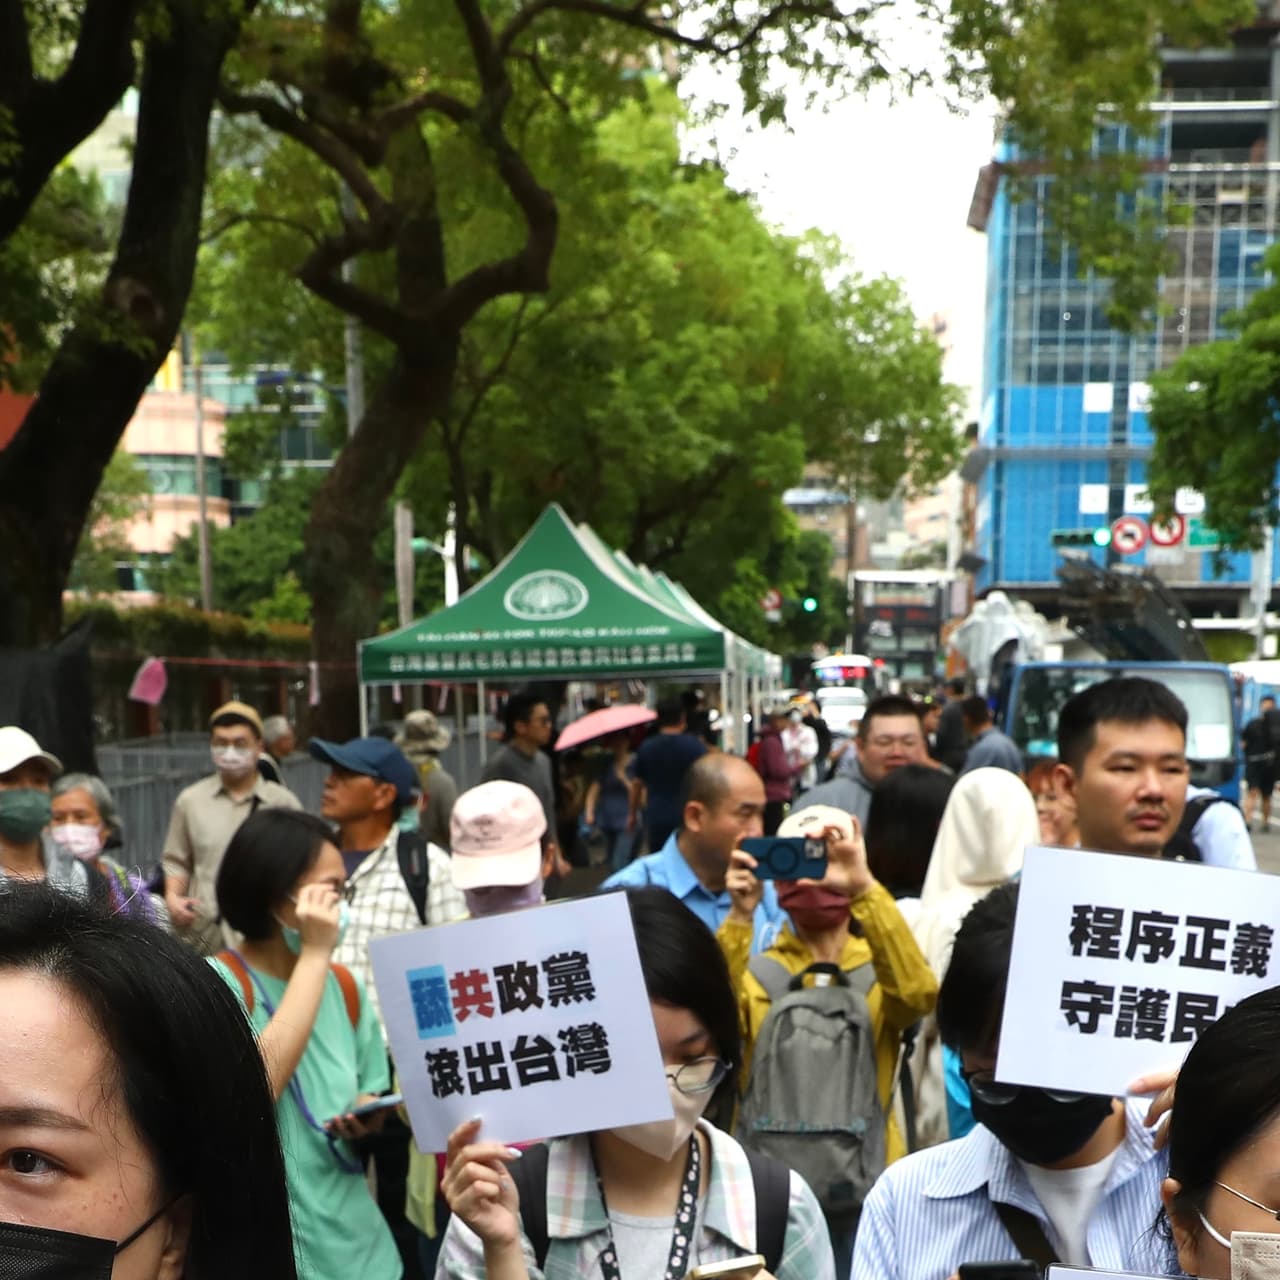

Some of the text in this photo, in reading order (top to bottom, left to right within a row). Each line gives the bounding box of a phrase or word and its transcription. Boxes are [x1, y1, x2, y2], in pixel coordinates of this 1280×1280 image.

[1069, 904, 1274, 978] 程序正義
[1060, 980, 1240, 1044] 守護民
[425, 1022, 611, 1099] 滾出台灣
